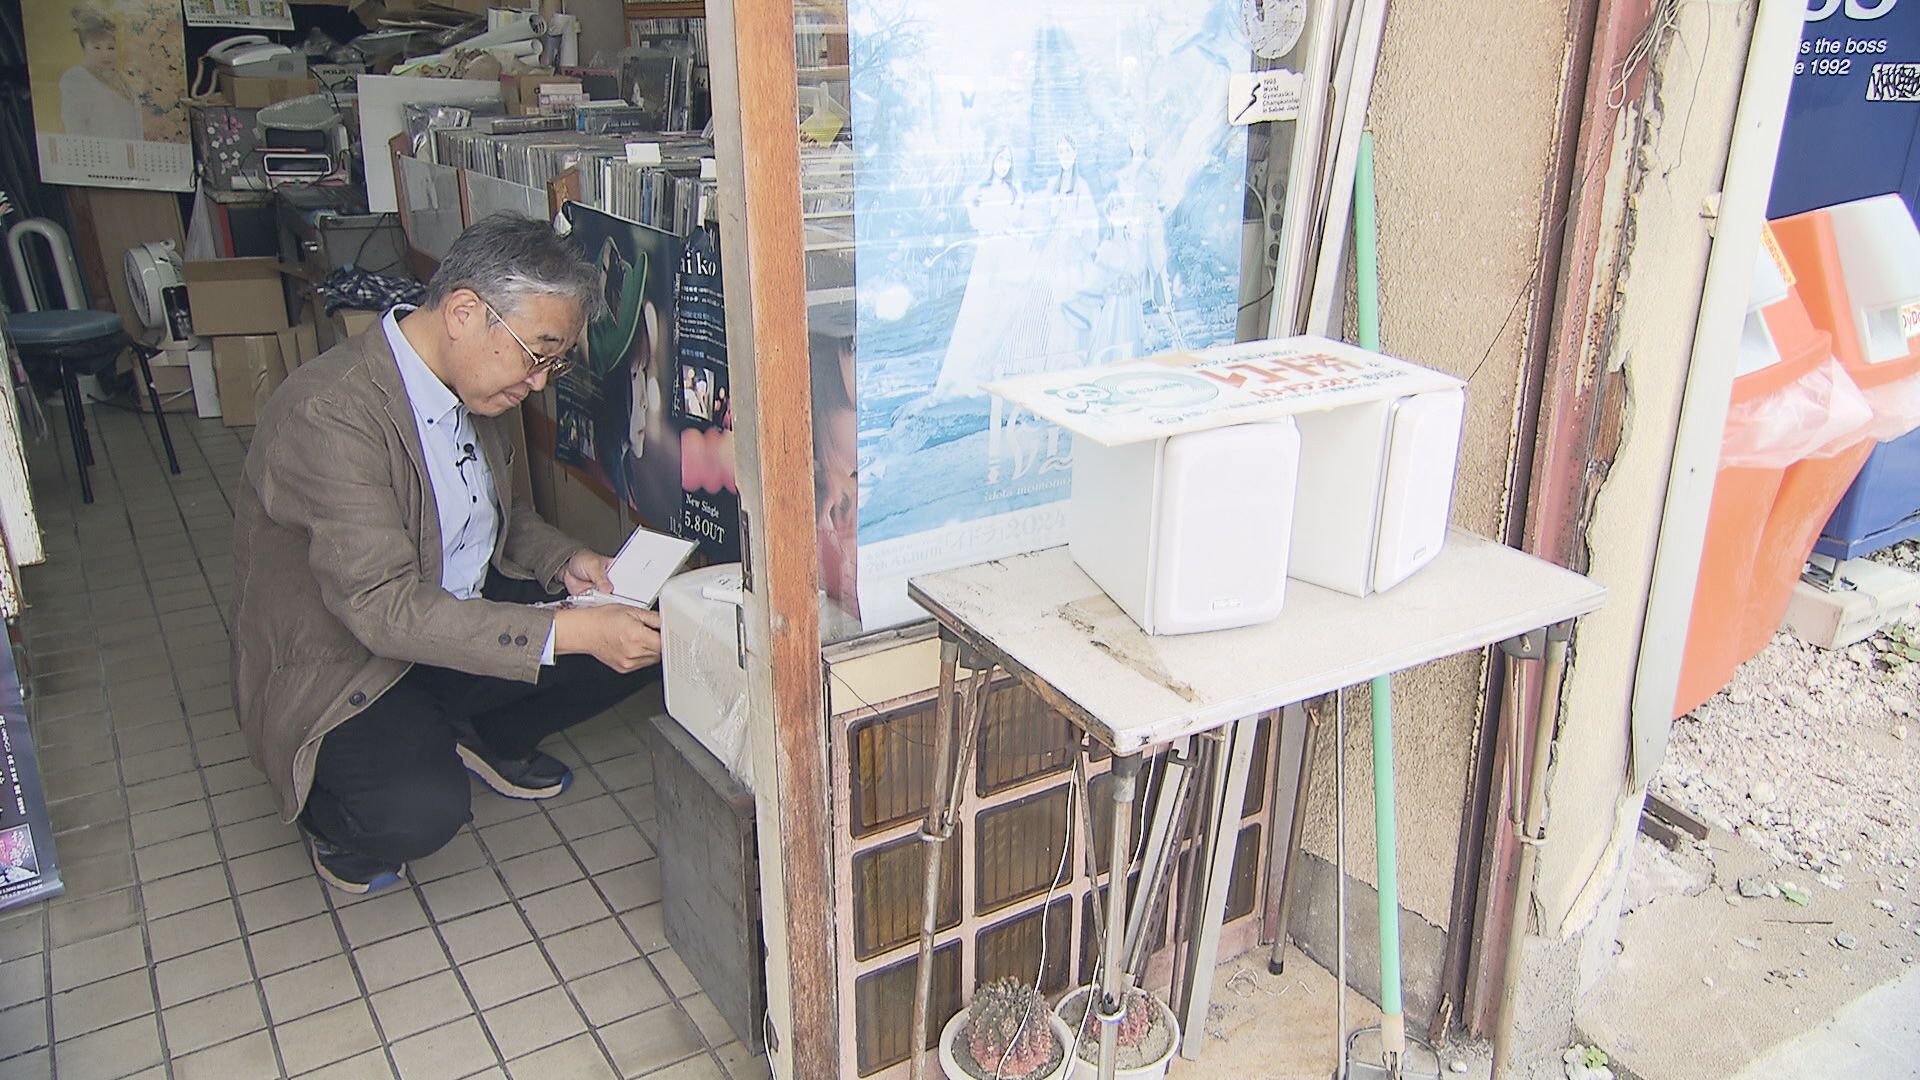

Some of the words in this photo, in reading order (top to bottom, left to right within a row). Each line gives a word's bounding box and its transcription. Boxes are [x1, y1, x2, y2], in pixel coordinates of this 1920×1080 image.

[1800, 40, 1810, 54] s
[1815, 37, 1840, 54] the
[1845, 36, 1887, 54] boss
[1811, 57, 1850, 75] 1992
[685, 493, 700, 508] New
[701, 500, 719, 518] Single
